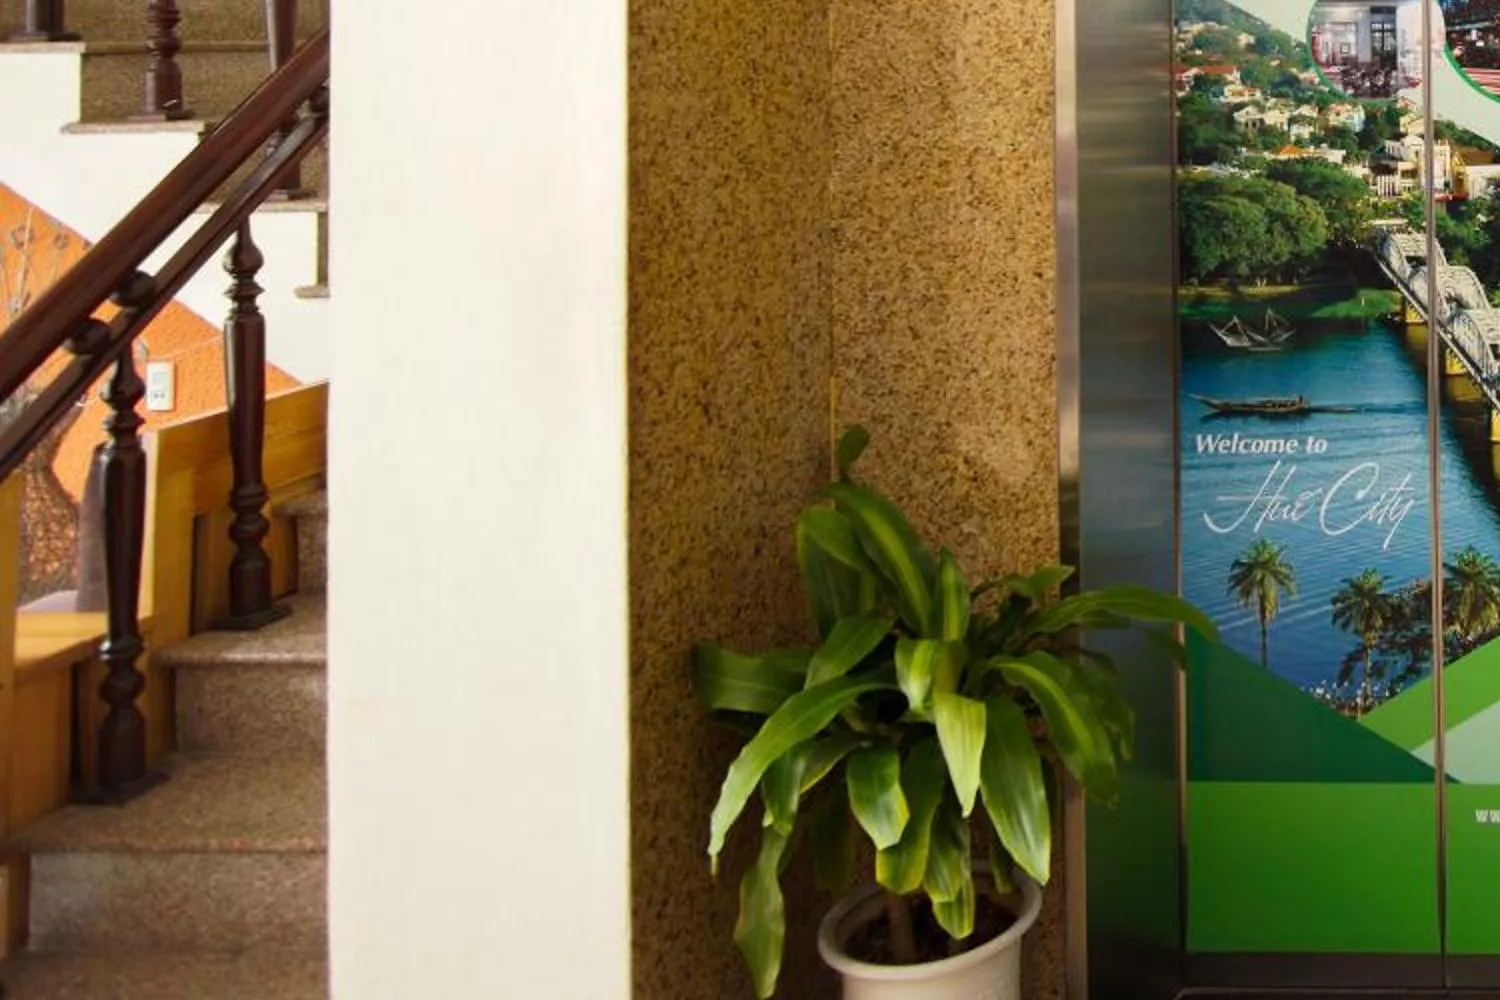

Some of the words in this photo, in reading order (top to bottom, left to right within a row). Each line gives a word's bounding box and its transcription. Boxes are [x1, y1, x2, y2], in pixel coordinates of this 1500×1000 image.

[1195, 433, 1298, 454] Welcome
[1306, 435, 1328, 454] to
[1319, 462, 1415, 550] City
